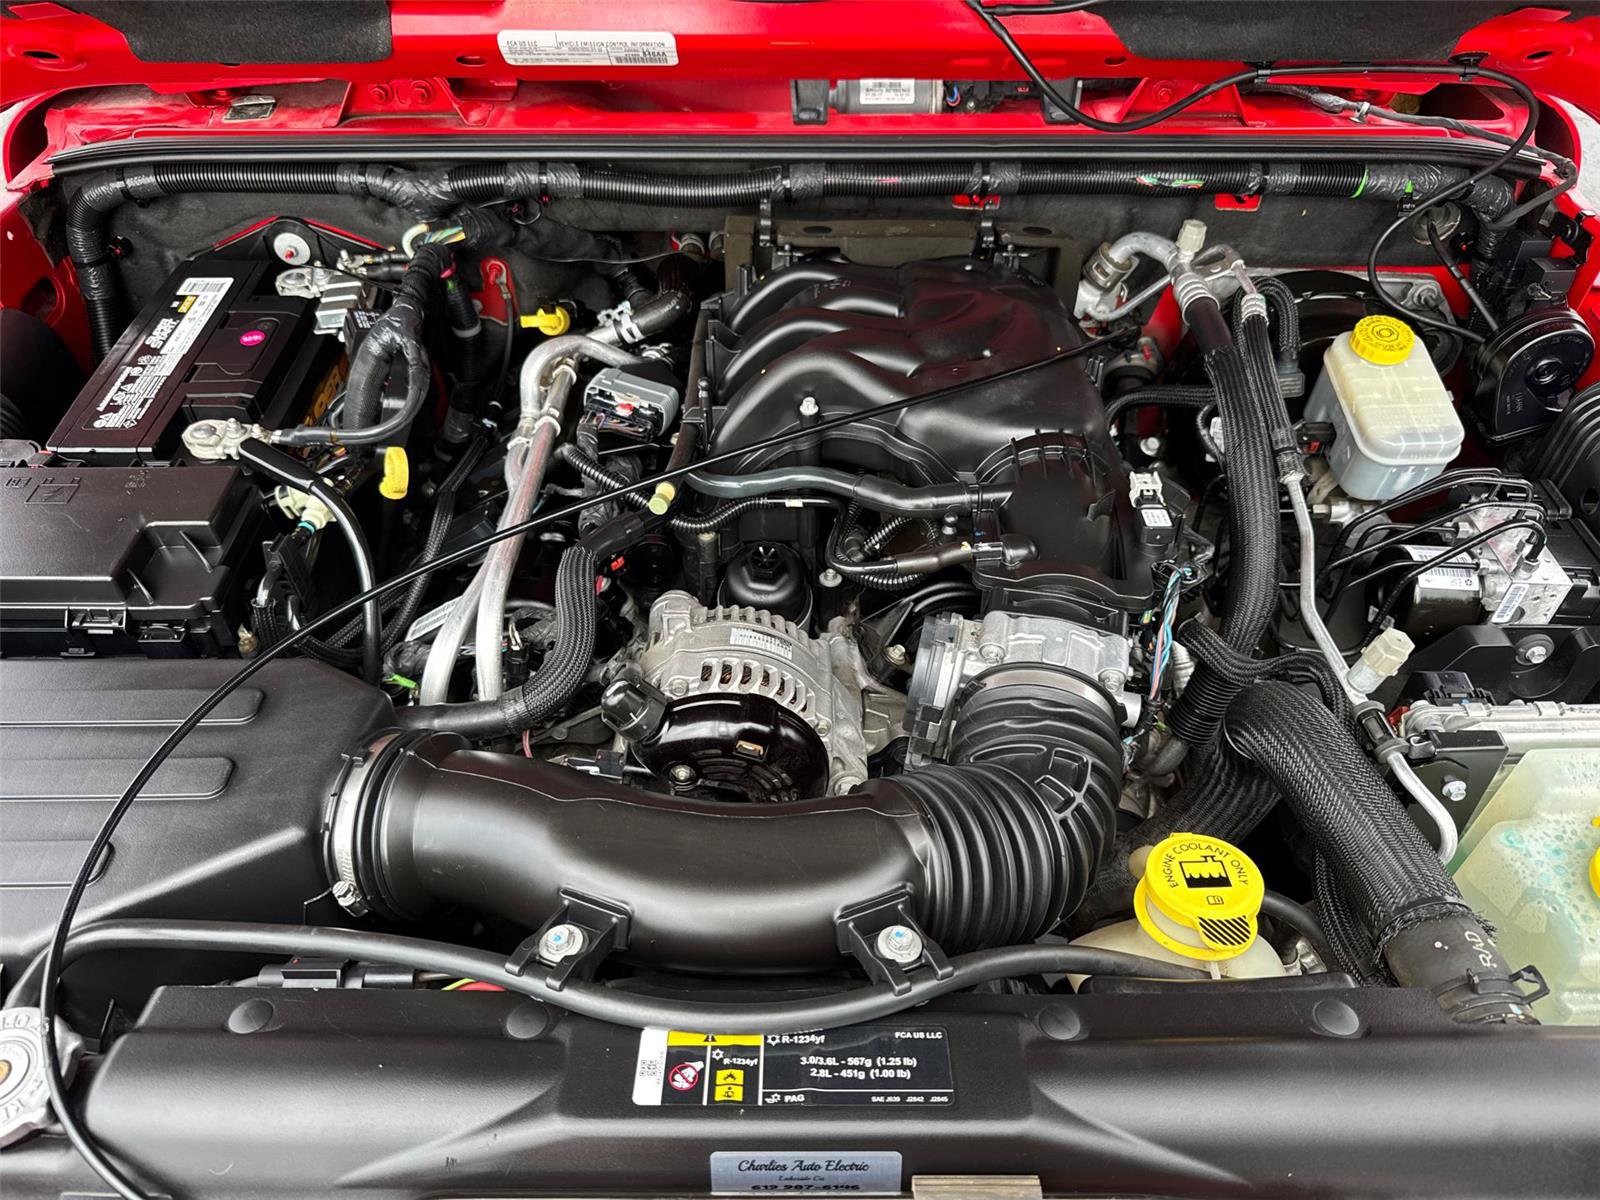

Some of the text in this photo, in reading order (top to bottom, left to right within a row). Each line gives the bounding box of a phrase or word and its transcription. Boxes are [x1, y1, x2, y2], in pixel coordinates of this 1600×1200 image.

[1162, 842, 1249, 888] ENGINE COOLANT ONLY
[781, 1034, 825, 1045] R-1234yf
[723, 1058, 758, 1066] R-1234yf
[800, 1056, 839, 1066] 3.0/3.6L
[847, 1057, 872, 1067] 567g
[876, 1057, 901, 1067] (1.25
[903, 1057, 917, 1067] lb)
[810, 1068, 832, 1078] 2.8L
[840, 1069, 865, 1079] 451g
[870, 1069, 895, 1079] (1.00
[897, 1069, 911, 1079] lb)
[785, 1094, 805, 1103] PAG
[738, 1160, 870, 1171] Charlies Auto Electric
